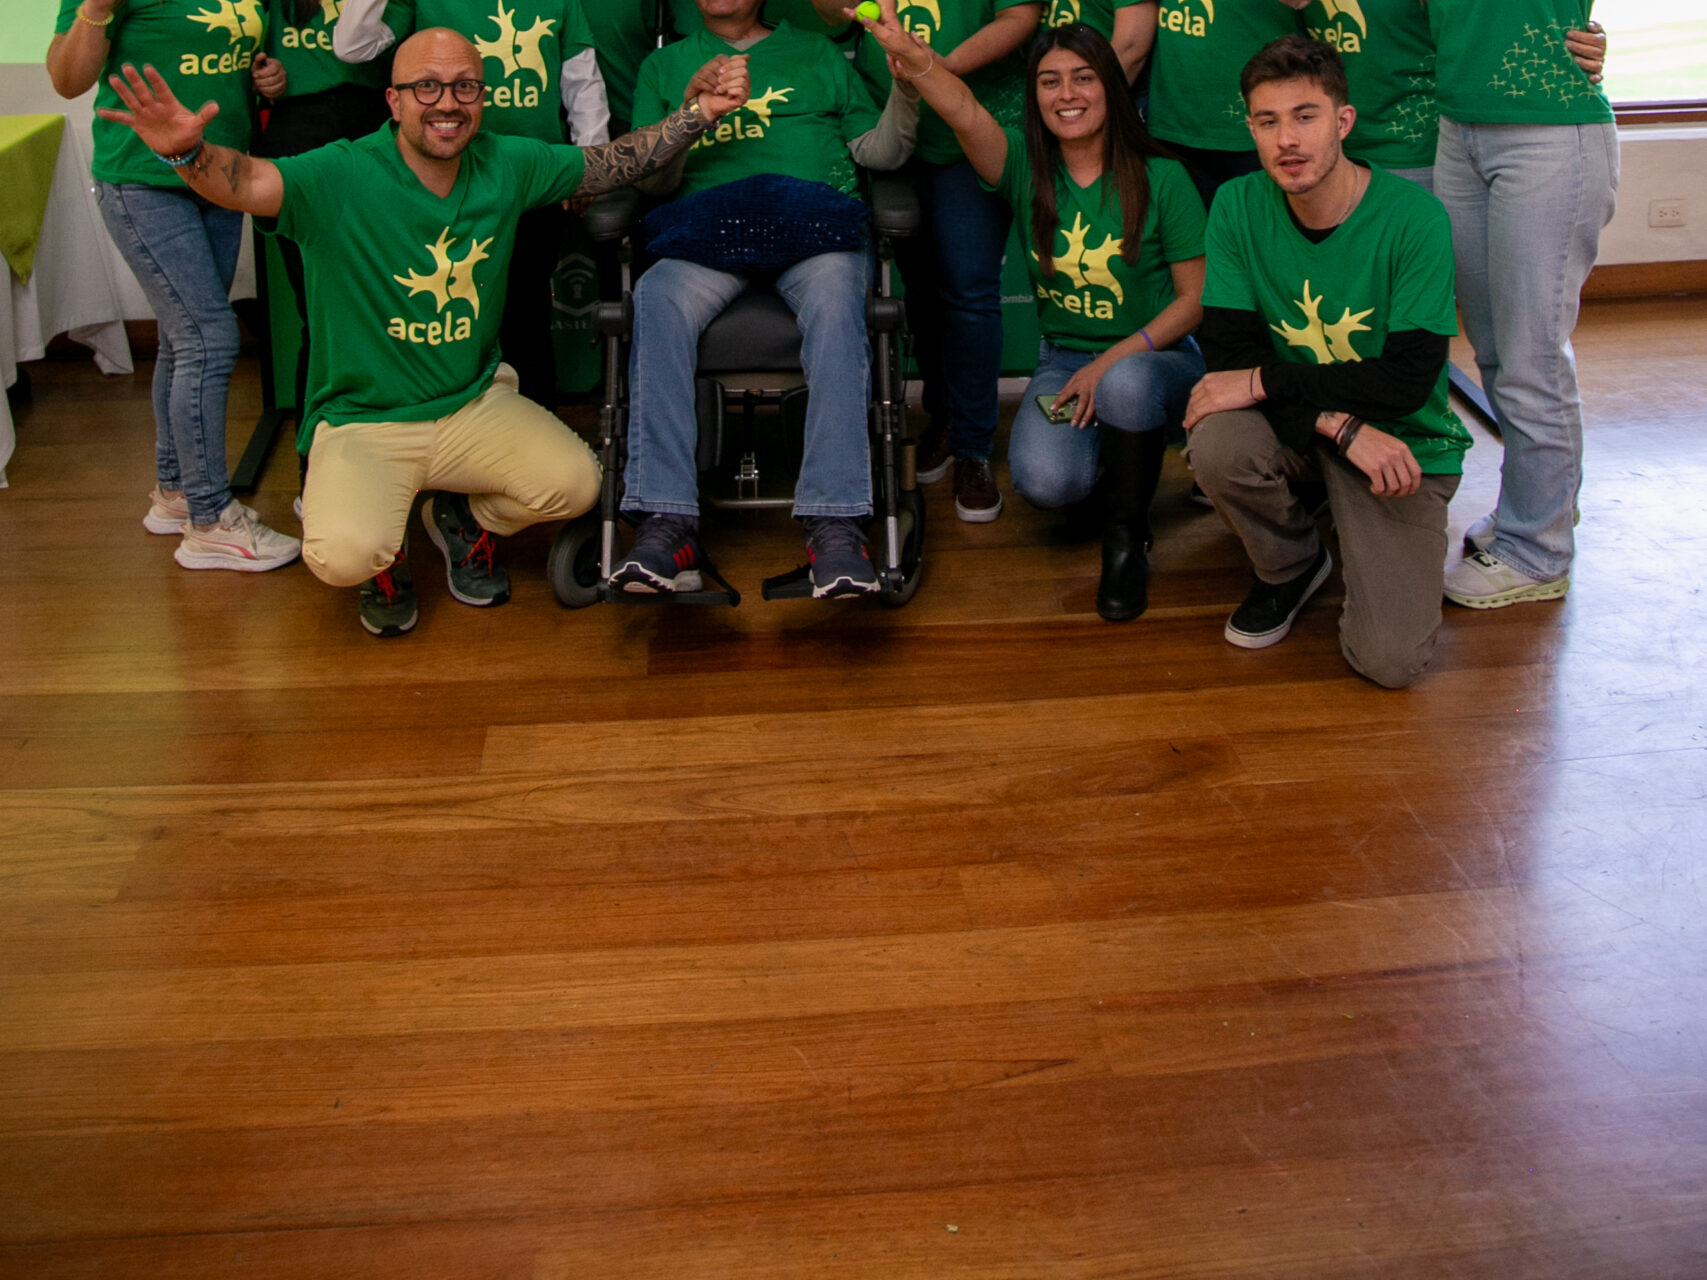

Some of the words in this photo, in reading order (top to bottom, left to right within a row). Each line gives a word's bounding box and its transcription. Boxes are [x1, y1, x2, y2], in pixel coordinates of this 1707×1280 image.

[1159, 6, 1206, 37] cela
[281, 26, 333, 51] ace
[179, 44, 252, 75] acela
[387, 311, 471, 346] acela
